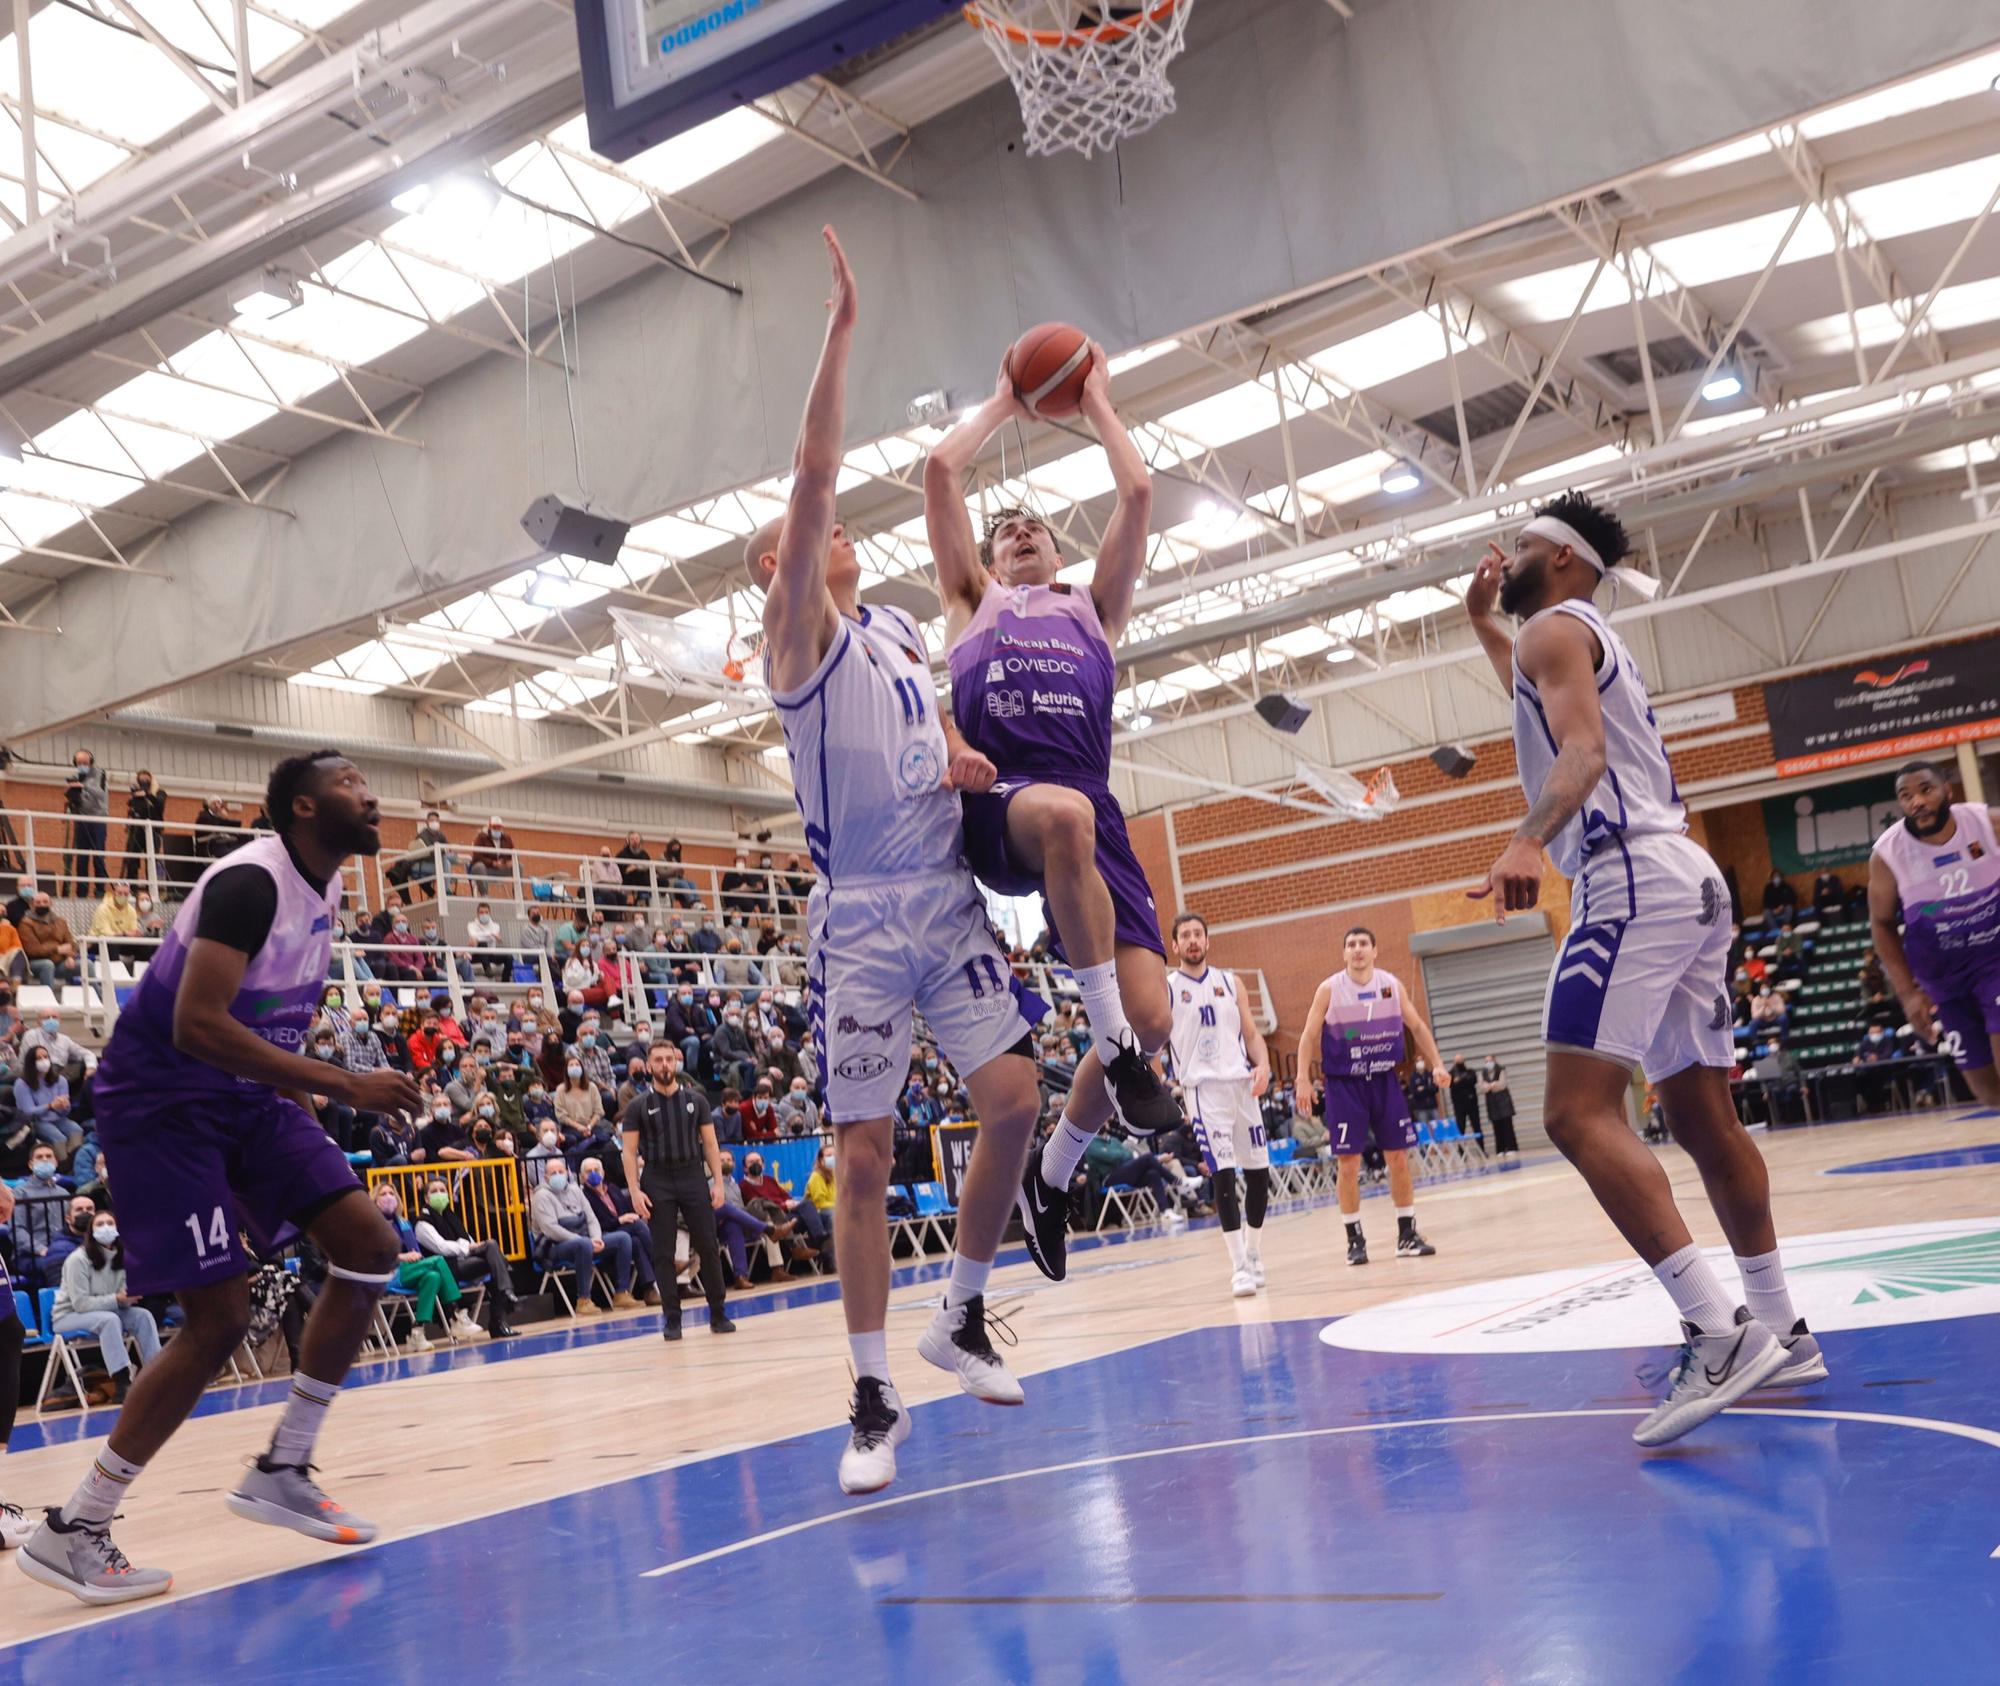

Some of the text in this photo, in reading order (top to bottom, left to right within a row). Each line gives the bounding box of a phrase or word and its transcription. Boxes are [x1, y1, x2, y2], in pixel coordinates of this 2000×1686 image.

[1006, 658, 1074, 675] OVIEDO
[895, 677, 925, 725] 11
[1940, 868, 1975, 899] 22
[963, 954, 1004, 999] 11
[1199, 1005, 1216, 1027] 10
[1363, 1001, 1374, 1022] 7
[1248, 1125, 1267, 1148] 10
[1337, 1122, 1348, 1144] 7
[950, 1140, 972, 1168] WE
[185, 1205, 230, 1256] 14
